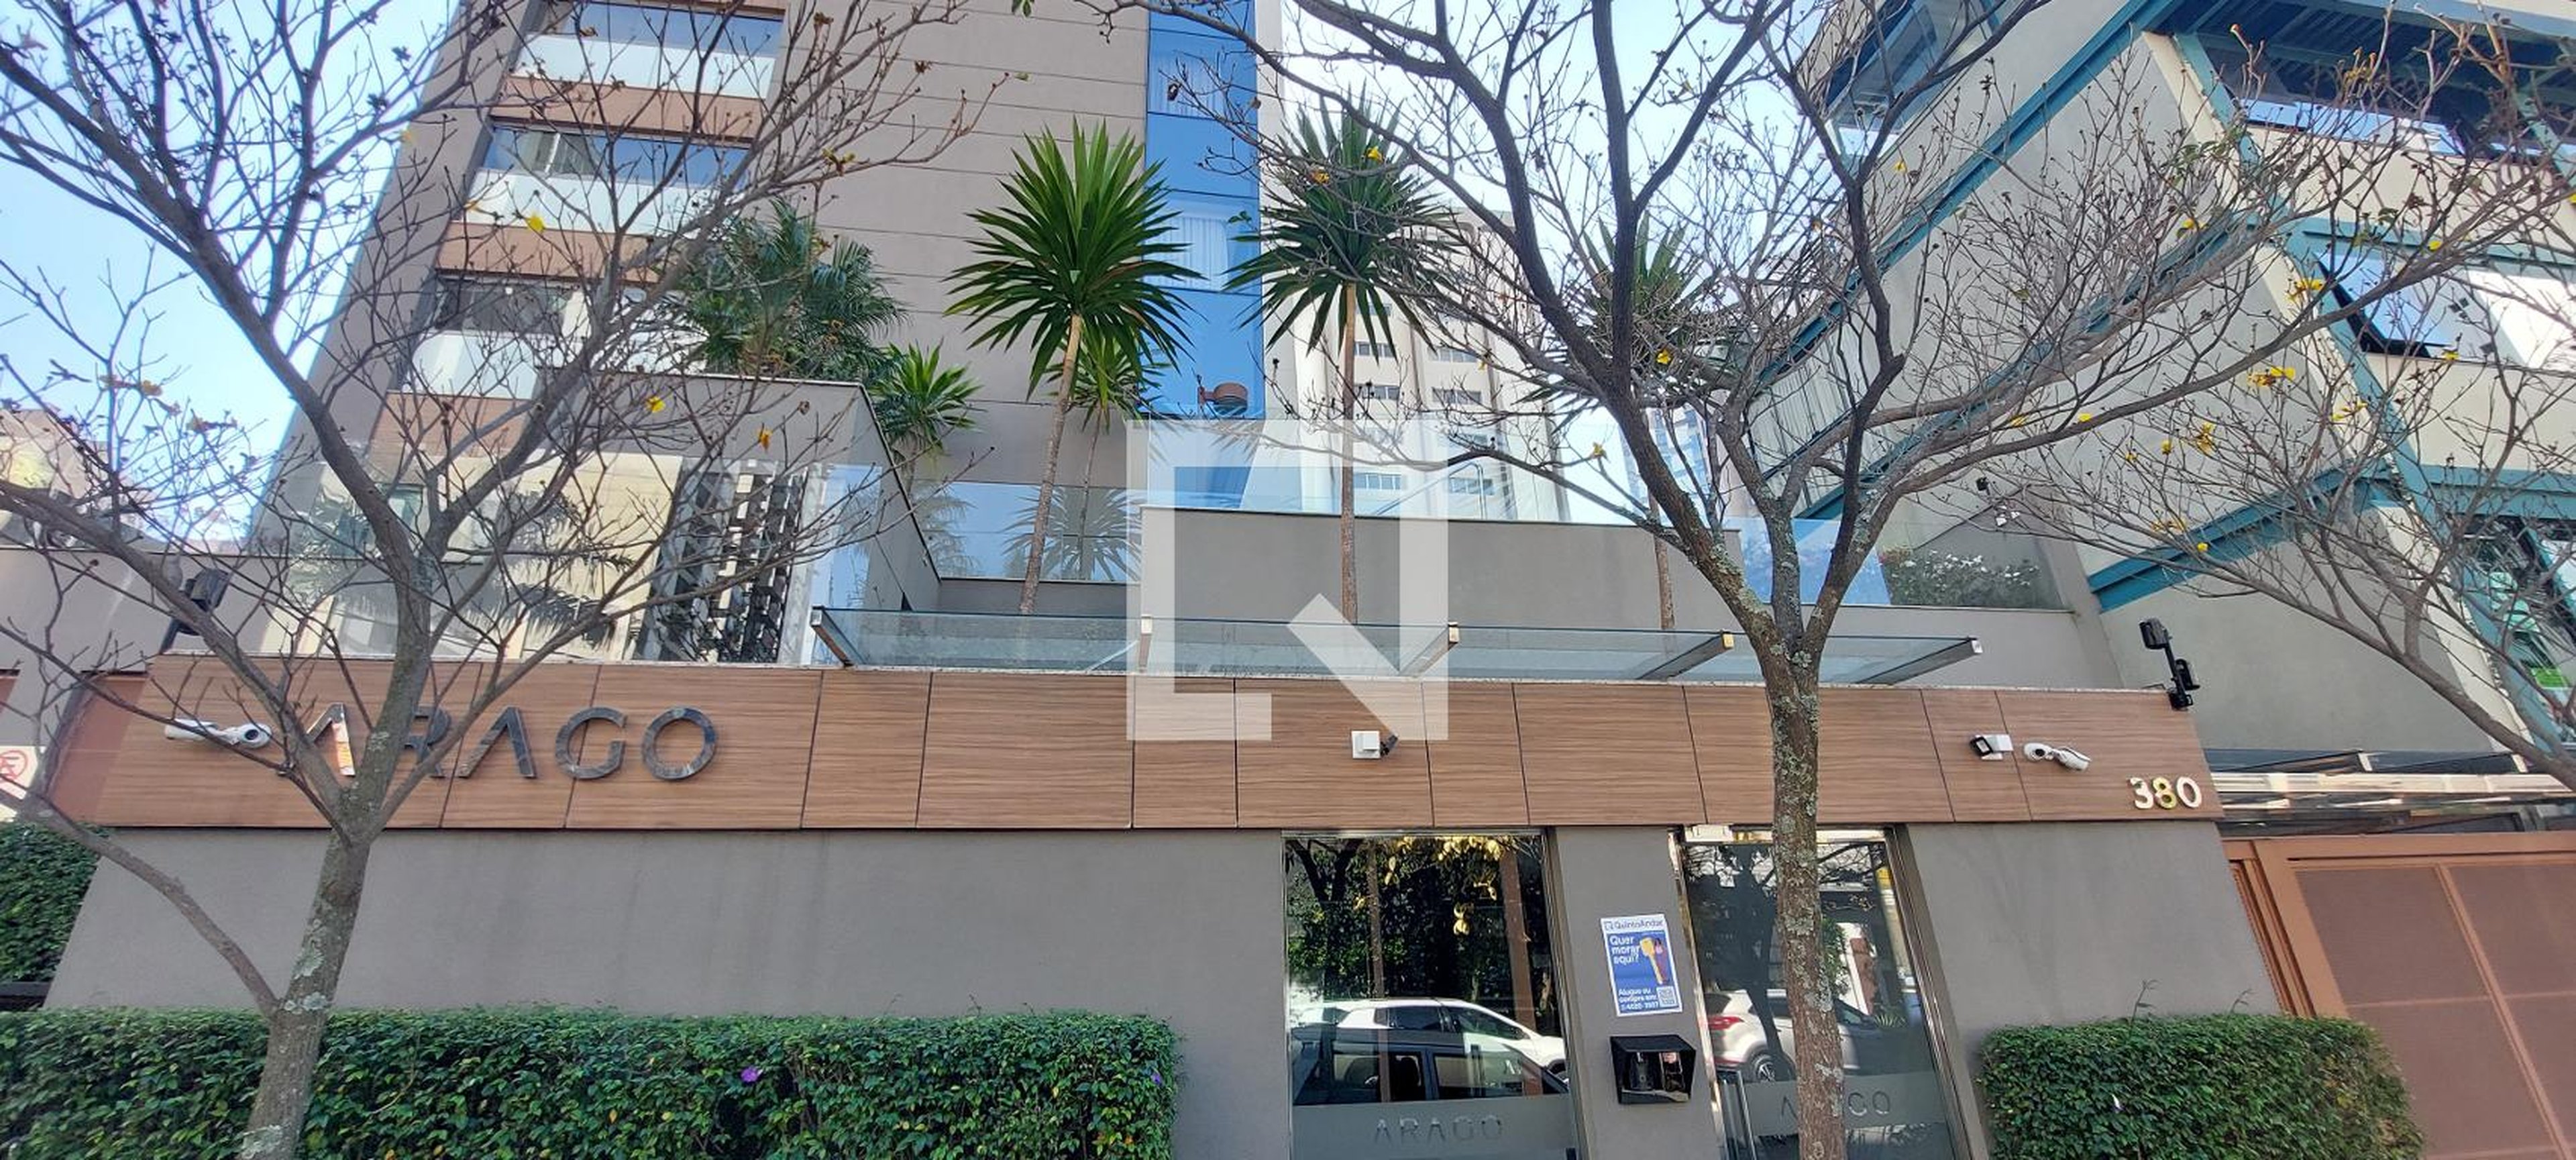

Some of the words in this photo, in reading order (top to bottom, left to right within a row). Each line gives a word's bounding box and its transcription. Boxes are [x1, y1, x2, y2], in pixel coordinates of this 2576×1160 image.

[2129, 776, 2203, 809] 380
[1610, 935, 1635, 945] Quer
[1611, 945, 1640, 955] morar
[1613, 953, 1639, 965] aqui?
[1781, 1090, 1890, 1120] AGO
